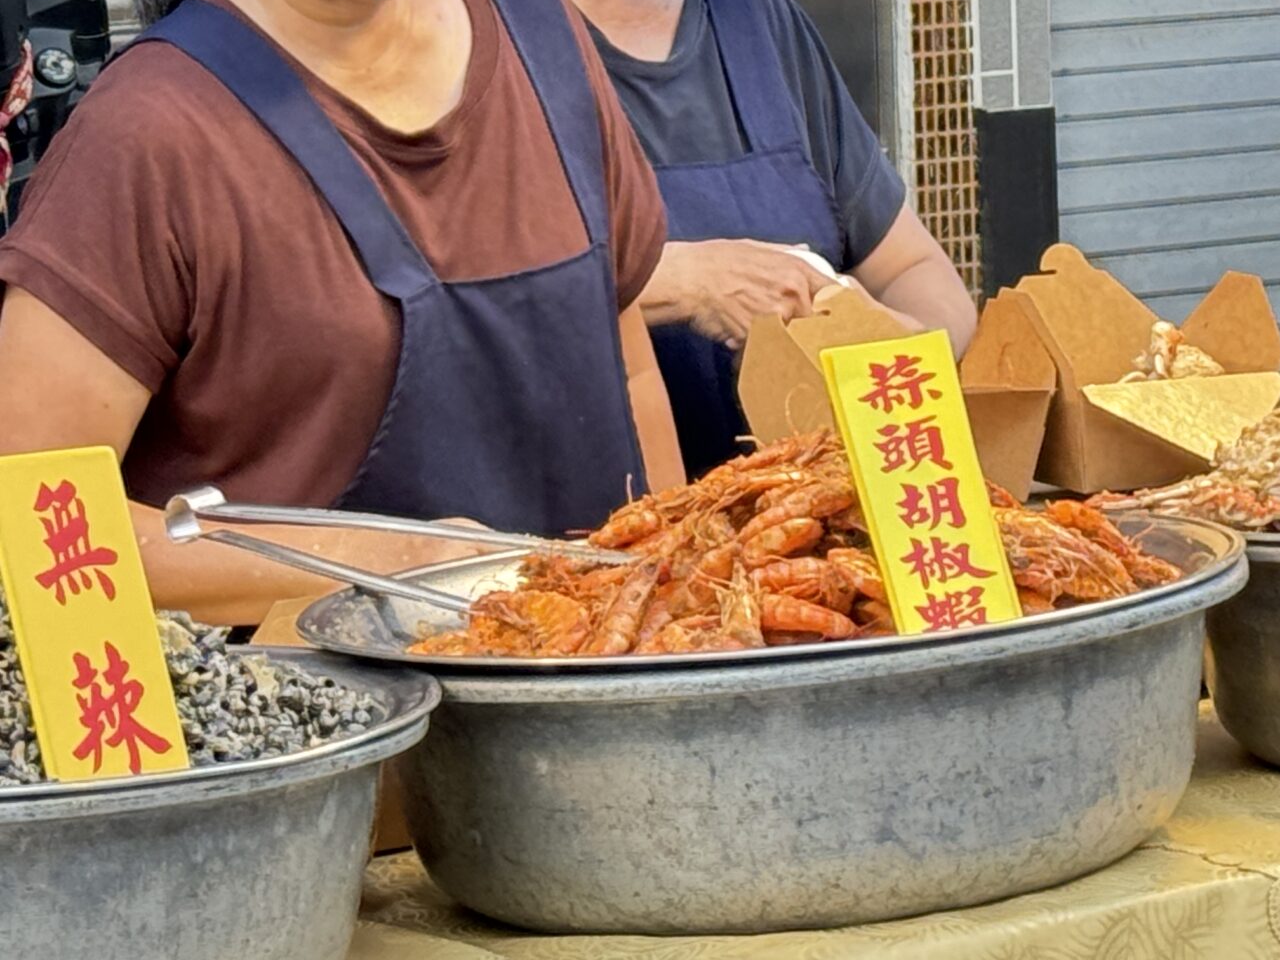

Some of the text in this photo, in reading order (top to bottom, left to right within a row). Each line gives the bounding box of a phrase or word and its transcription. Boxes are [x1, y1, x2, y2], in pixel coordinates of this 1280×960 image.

[33, 478, 173, 776] 無辣
[858, 354, 998, 635] 蒜頭胡椒蝦
